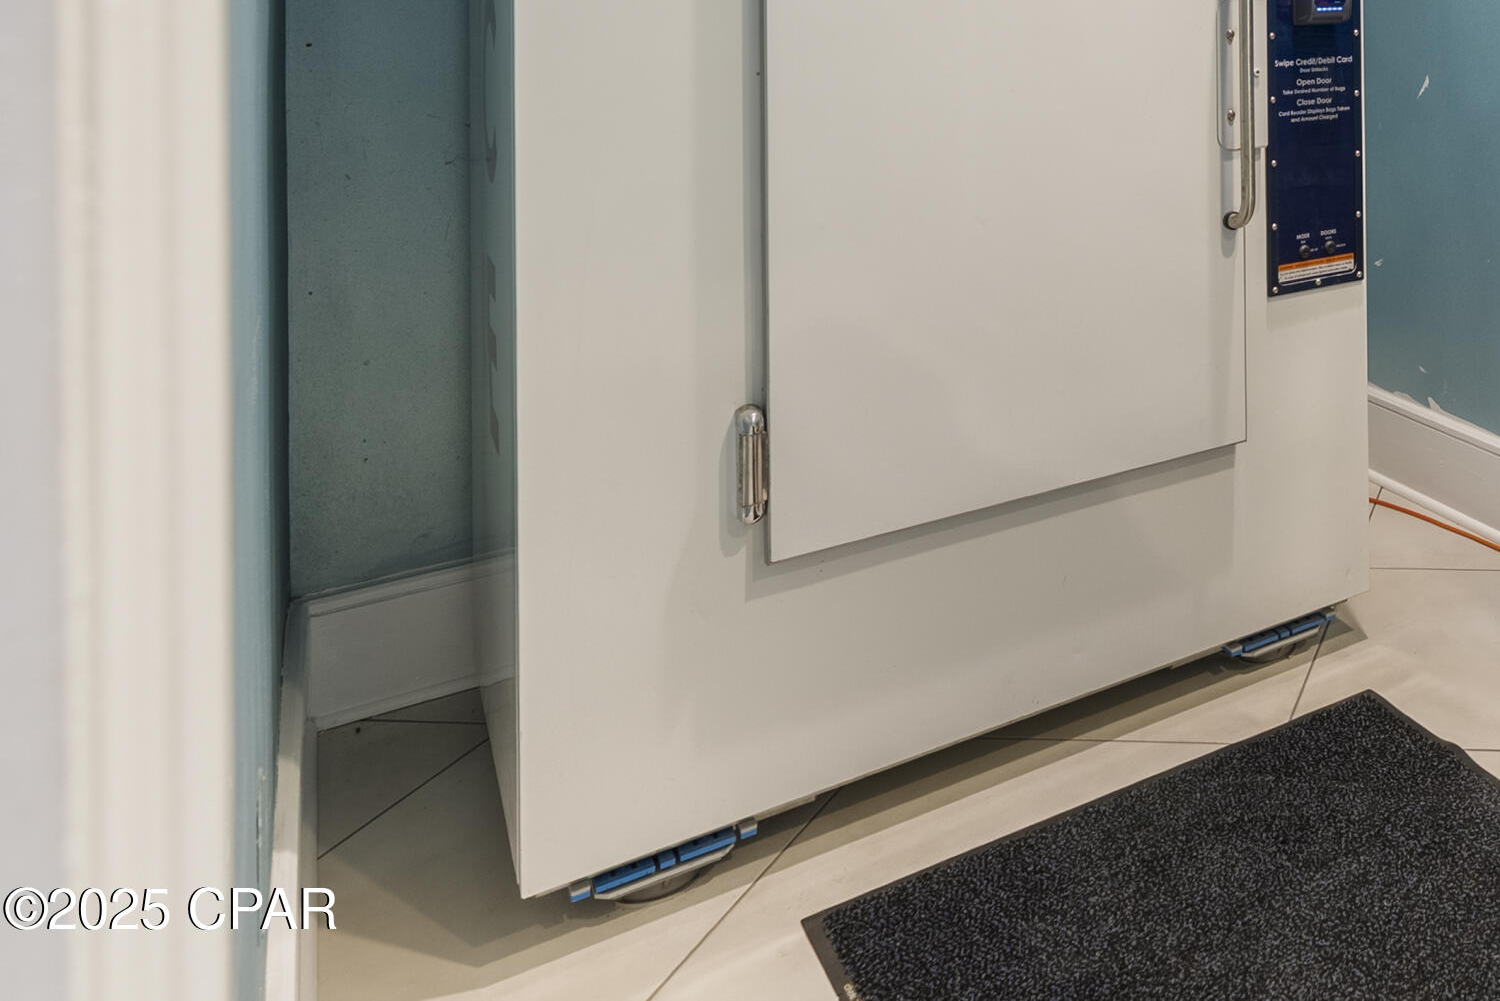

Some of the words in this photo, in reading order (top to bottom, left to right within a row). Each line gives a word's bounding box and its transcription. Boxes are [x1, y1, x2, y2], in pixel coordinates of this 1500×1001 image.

[1274, 58, 1294, 68] Swipe
[1295, 56, 1335, 67] Credit/Debit
[1336, 55, 1353, 64] Card
[1296, 78, 1316, 87] Open
[1316, 77, 1332, 85] Door
[1296, 98, 1316, 106] Close
[1316, 97, 1332, 105] Door
